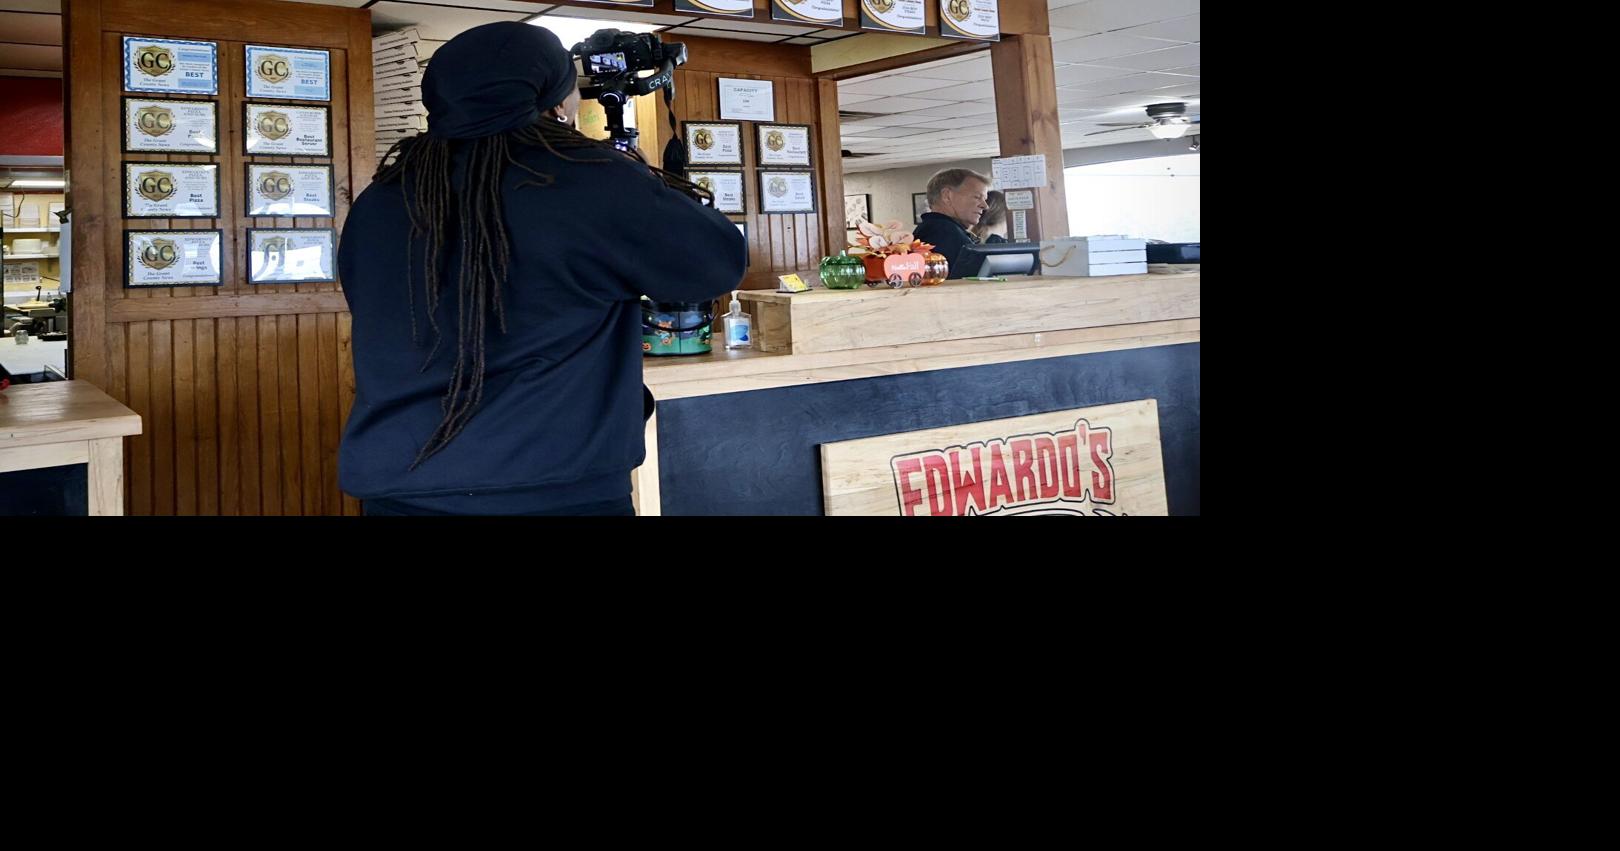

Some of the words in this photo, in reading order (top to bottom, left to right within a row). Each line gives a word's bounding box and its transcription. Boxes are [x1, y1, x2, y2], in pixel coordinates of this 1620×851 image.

[950, 0, 968, 15] GC
[141, 51, 171, 69] GC
[261, 60, 288, 77] GC
[142, 112, 170, 129] GC
[261, 117, 287, 133] GC
[696, 133, 712, 145] GC
[143, 177, 172, 193] GC
[263, 177, 290, 193] GC
[145, 245, 174, 262] GC
[896, 424, 1112, 516] EDWARDO'S
